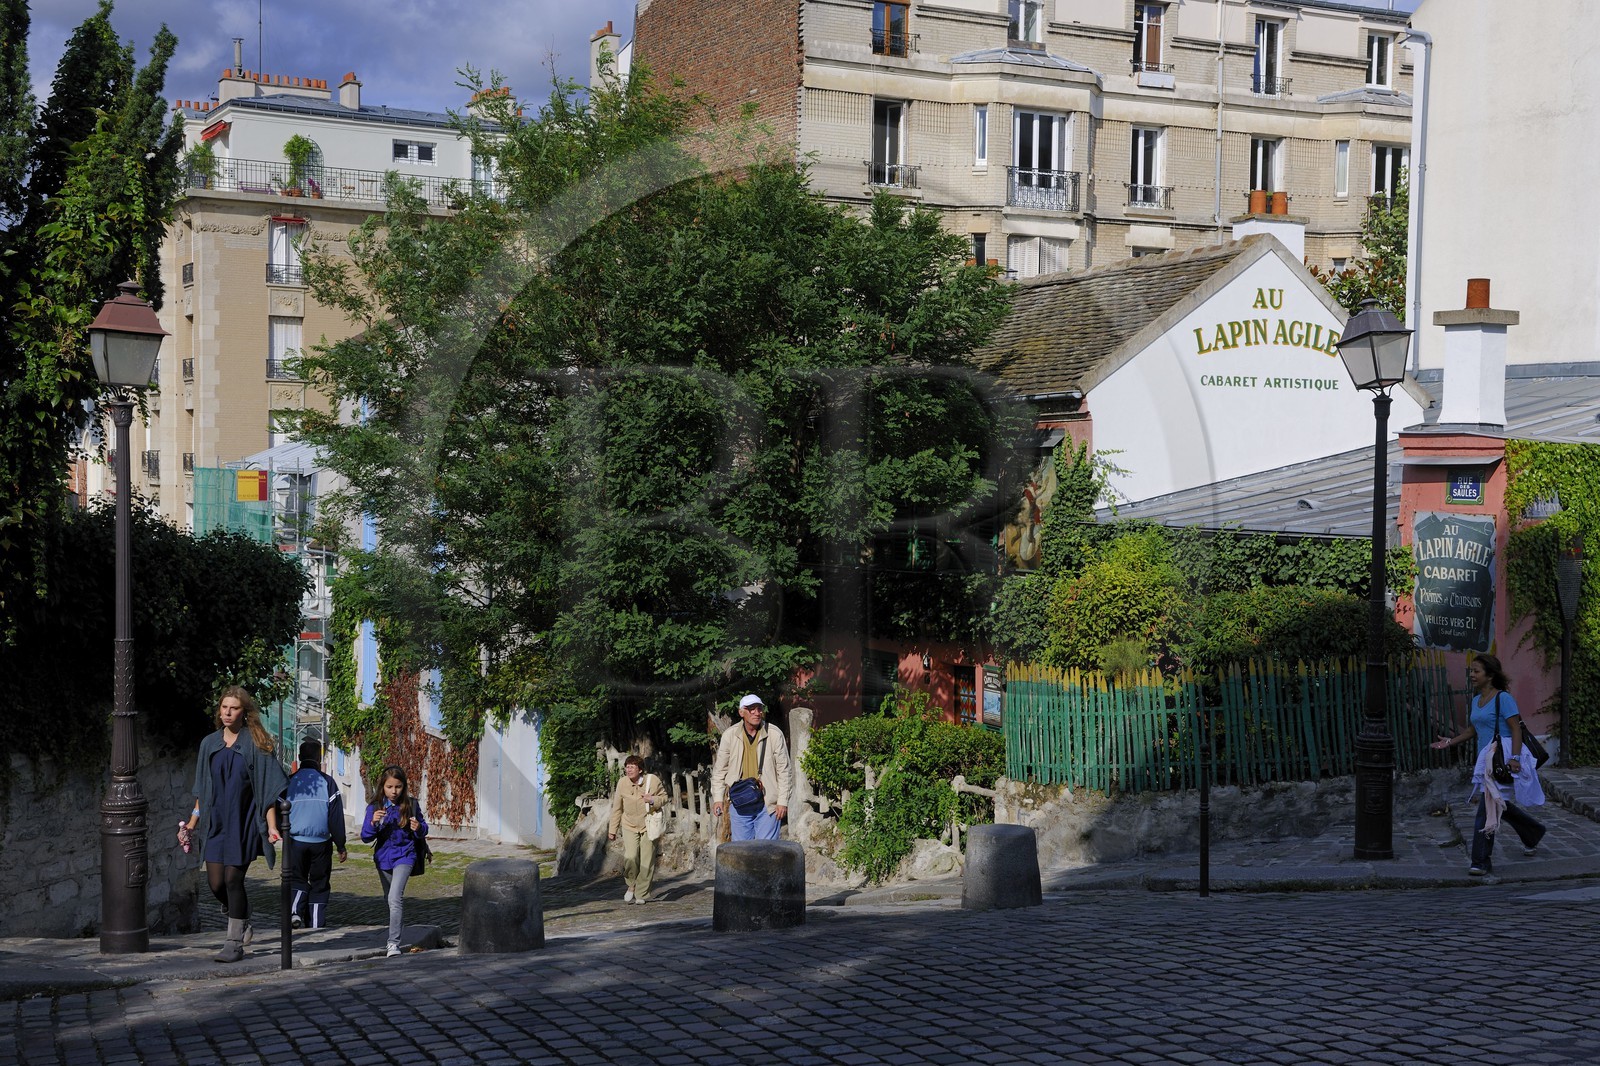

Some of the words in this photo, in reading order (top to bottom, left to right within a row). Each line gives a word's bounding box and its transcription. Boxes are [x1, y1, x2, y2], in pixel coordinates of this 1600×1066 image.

[1252, 288, 1284, 310] AU
[1193, 319, 1268, 355] LAPIN
[1273, 319, 1340, 358] AGILE
[1201, 375, 1257, 388] CABARET
[1264, 377, 1339, 391] ARTISTIQUE
[1457, 476, 1473, 485] RUE
[1452, 488, 1477, 497] SAULES
[1442, 525, 1459, 536] AU
[1418, 537, 1453, 561] LAPIN
[1454, 538, 1491, 568] AGILE
[1424, 565, 1478, 582] CABARET
[1450, 617, 1464, 628] VERS
